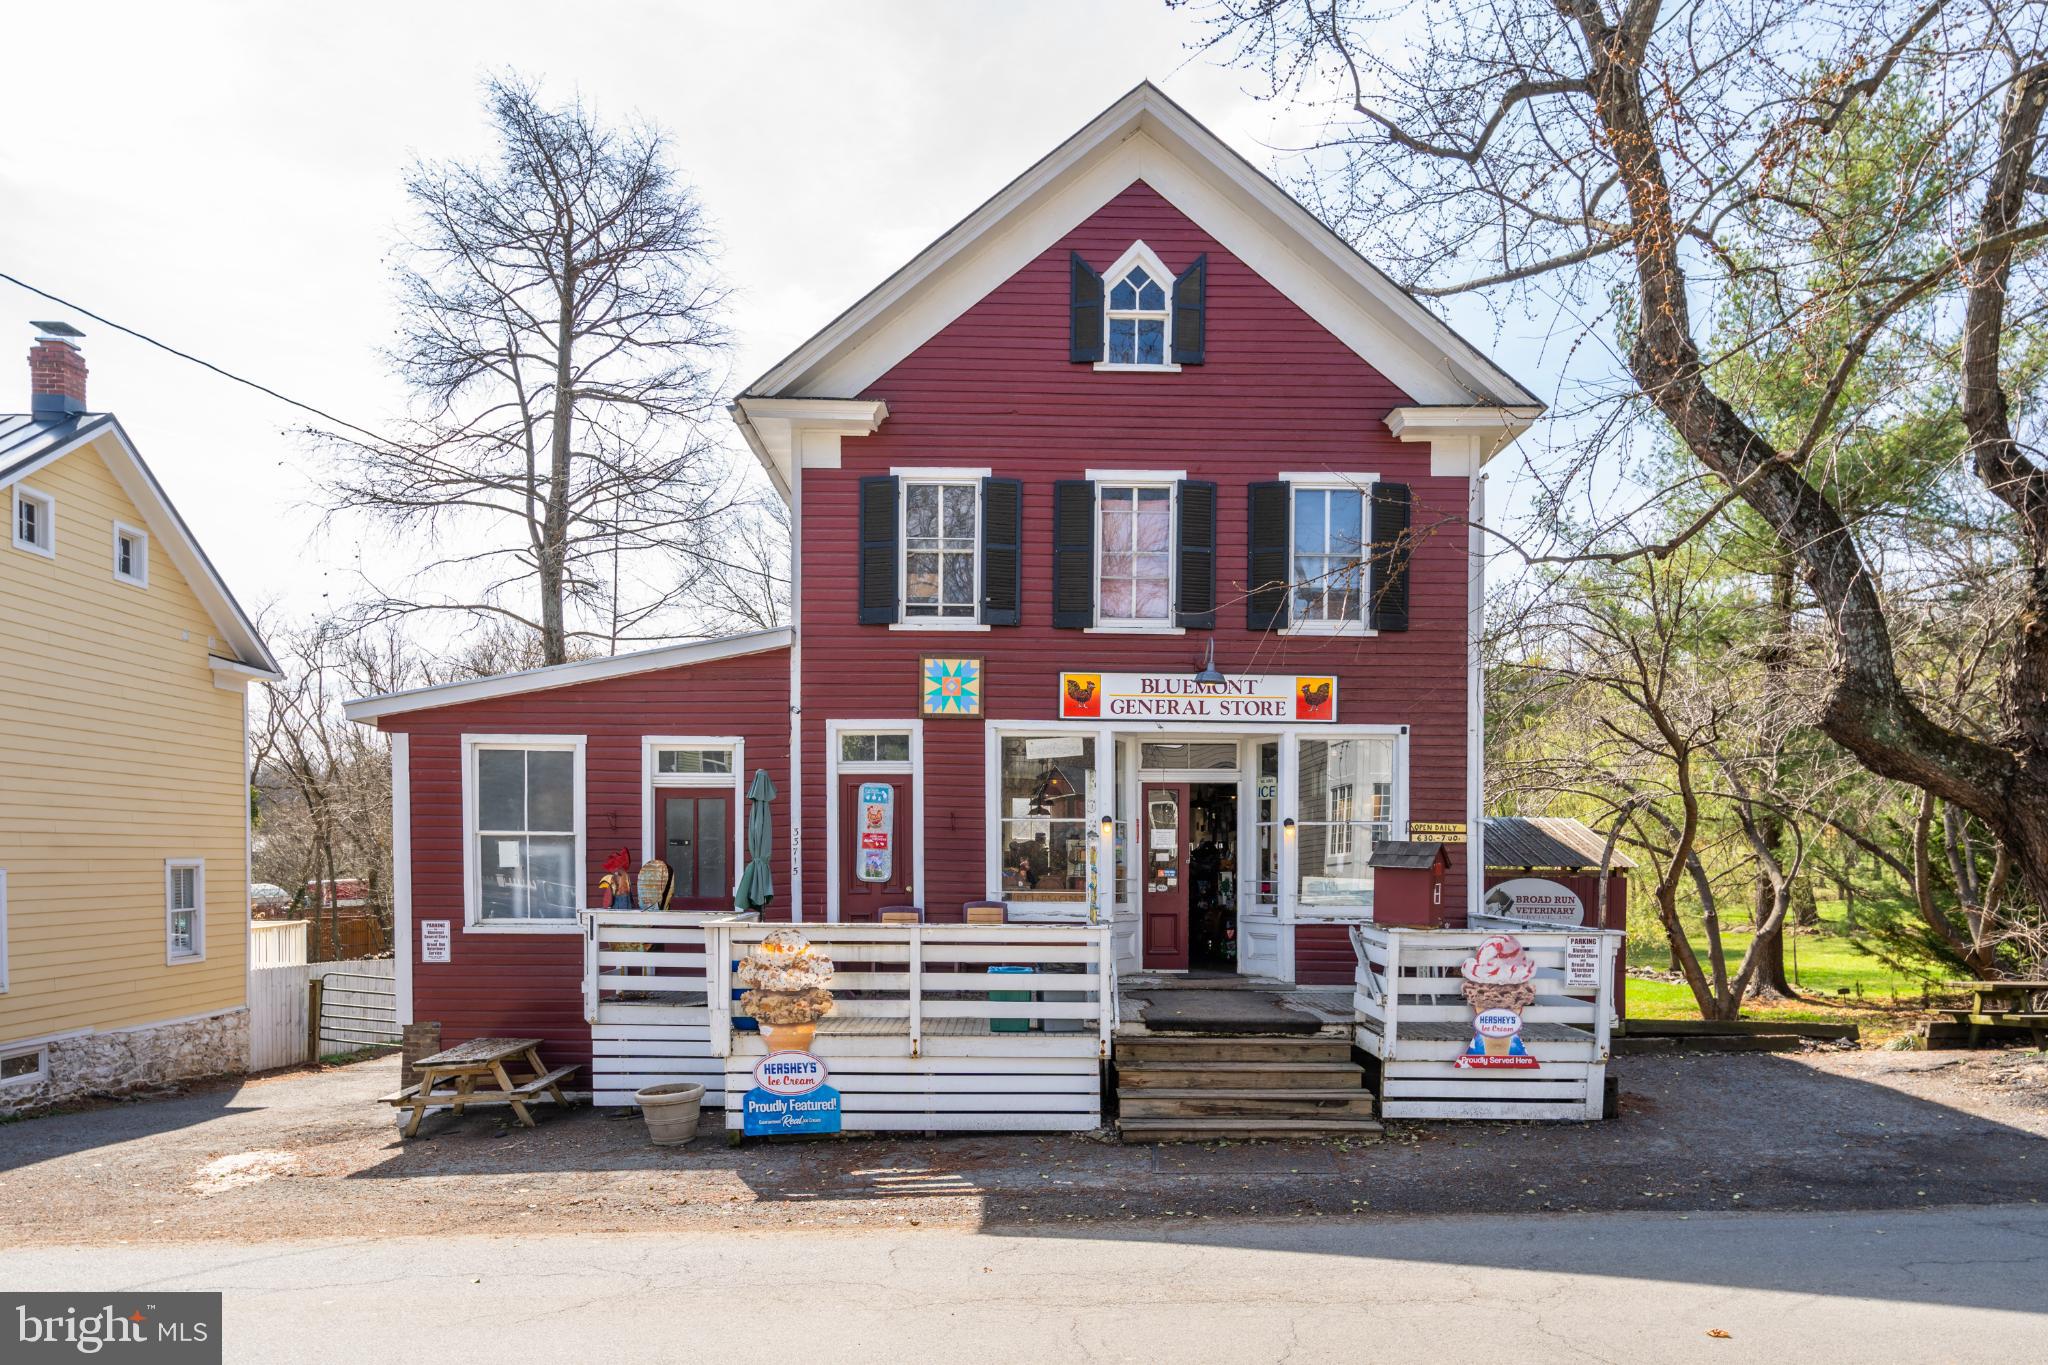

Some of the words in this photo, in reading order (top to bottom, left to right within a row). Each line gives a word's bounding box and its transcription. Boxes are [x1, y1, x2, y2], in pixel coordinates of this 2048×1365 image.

[1140, 678, 1258, 695] BLUEMONT
[1110, 699, 1210, 716] GENERAL
[1219, 700, 1286, 716] STORE
[1258, 785, 1276, 797] ICE
[1434, 824, 1457, 832] DAILY
[1516, 895, 1552, 904] BROAD
[1554, 895, 1576, 904] RUN
[1516, 906, 1575, 915] VETERINARY
[1480, 1016, 1516, 1024] HERSHEY'S
[1461, 1056, 1488, 1065] Proudly
[1489, 1056, 1514, 1064] Served
[1515, 1056, 1533, 1064] Here
[764, 1062, 817, 1075] HERSHEY'S
[768, 1075, 781, 1086] Ice
[783, 1075, 816, 1086] Cream
[748, 1100, 788, 1114] Proudly
[789, 1098, 837, 1111] Featured!
[781, 1114, 803, 1128] Real
